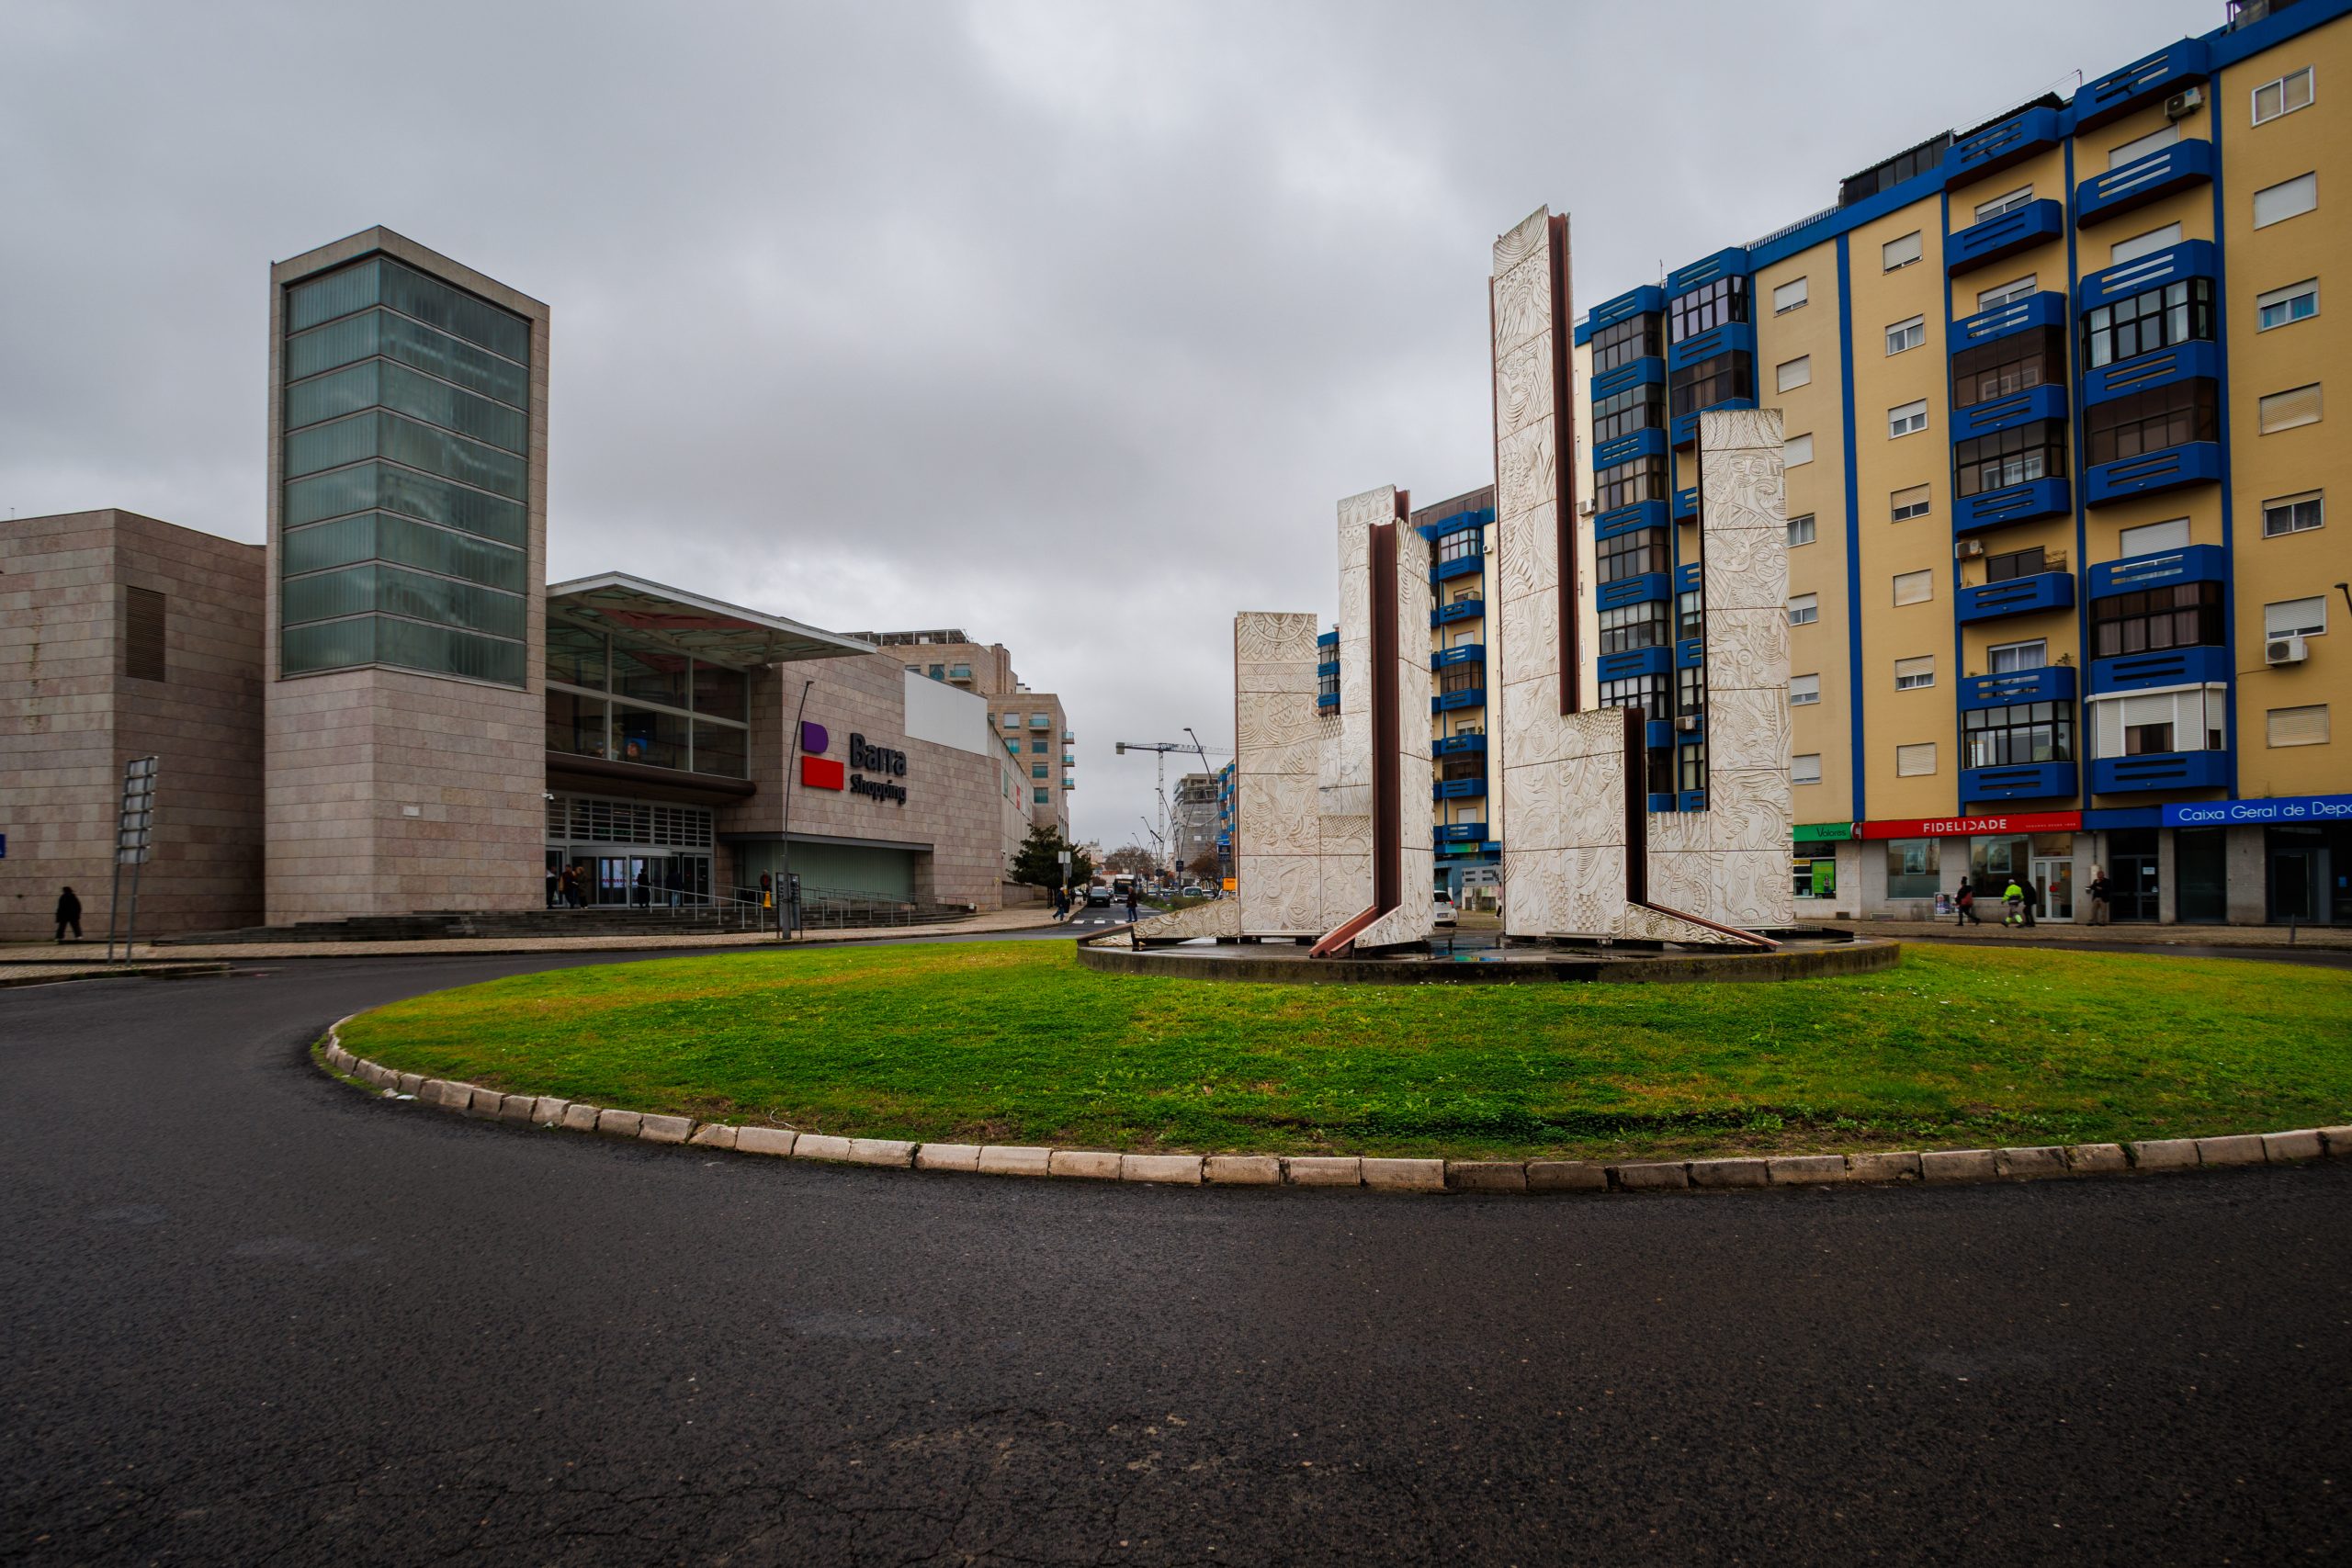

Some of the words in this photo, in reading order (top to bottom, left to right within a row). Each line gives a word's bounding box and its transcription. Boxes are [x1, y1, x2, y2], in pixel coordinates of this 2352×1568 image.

[850, 732, 907, 776] Barra
[850, 773, 907, 806] Shopping
[2178, 807, 2225, 821] Caixa
[2231, 805, 2277, 819] Geral
[2282, 804, 2305, 817] de
[1816, 827, 1847, 837] Valores
[1923, 818, 2007, 833] FIDELIDADE
